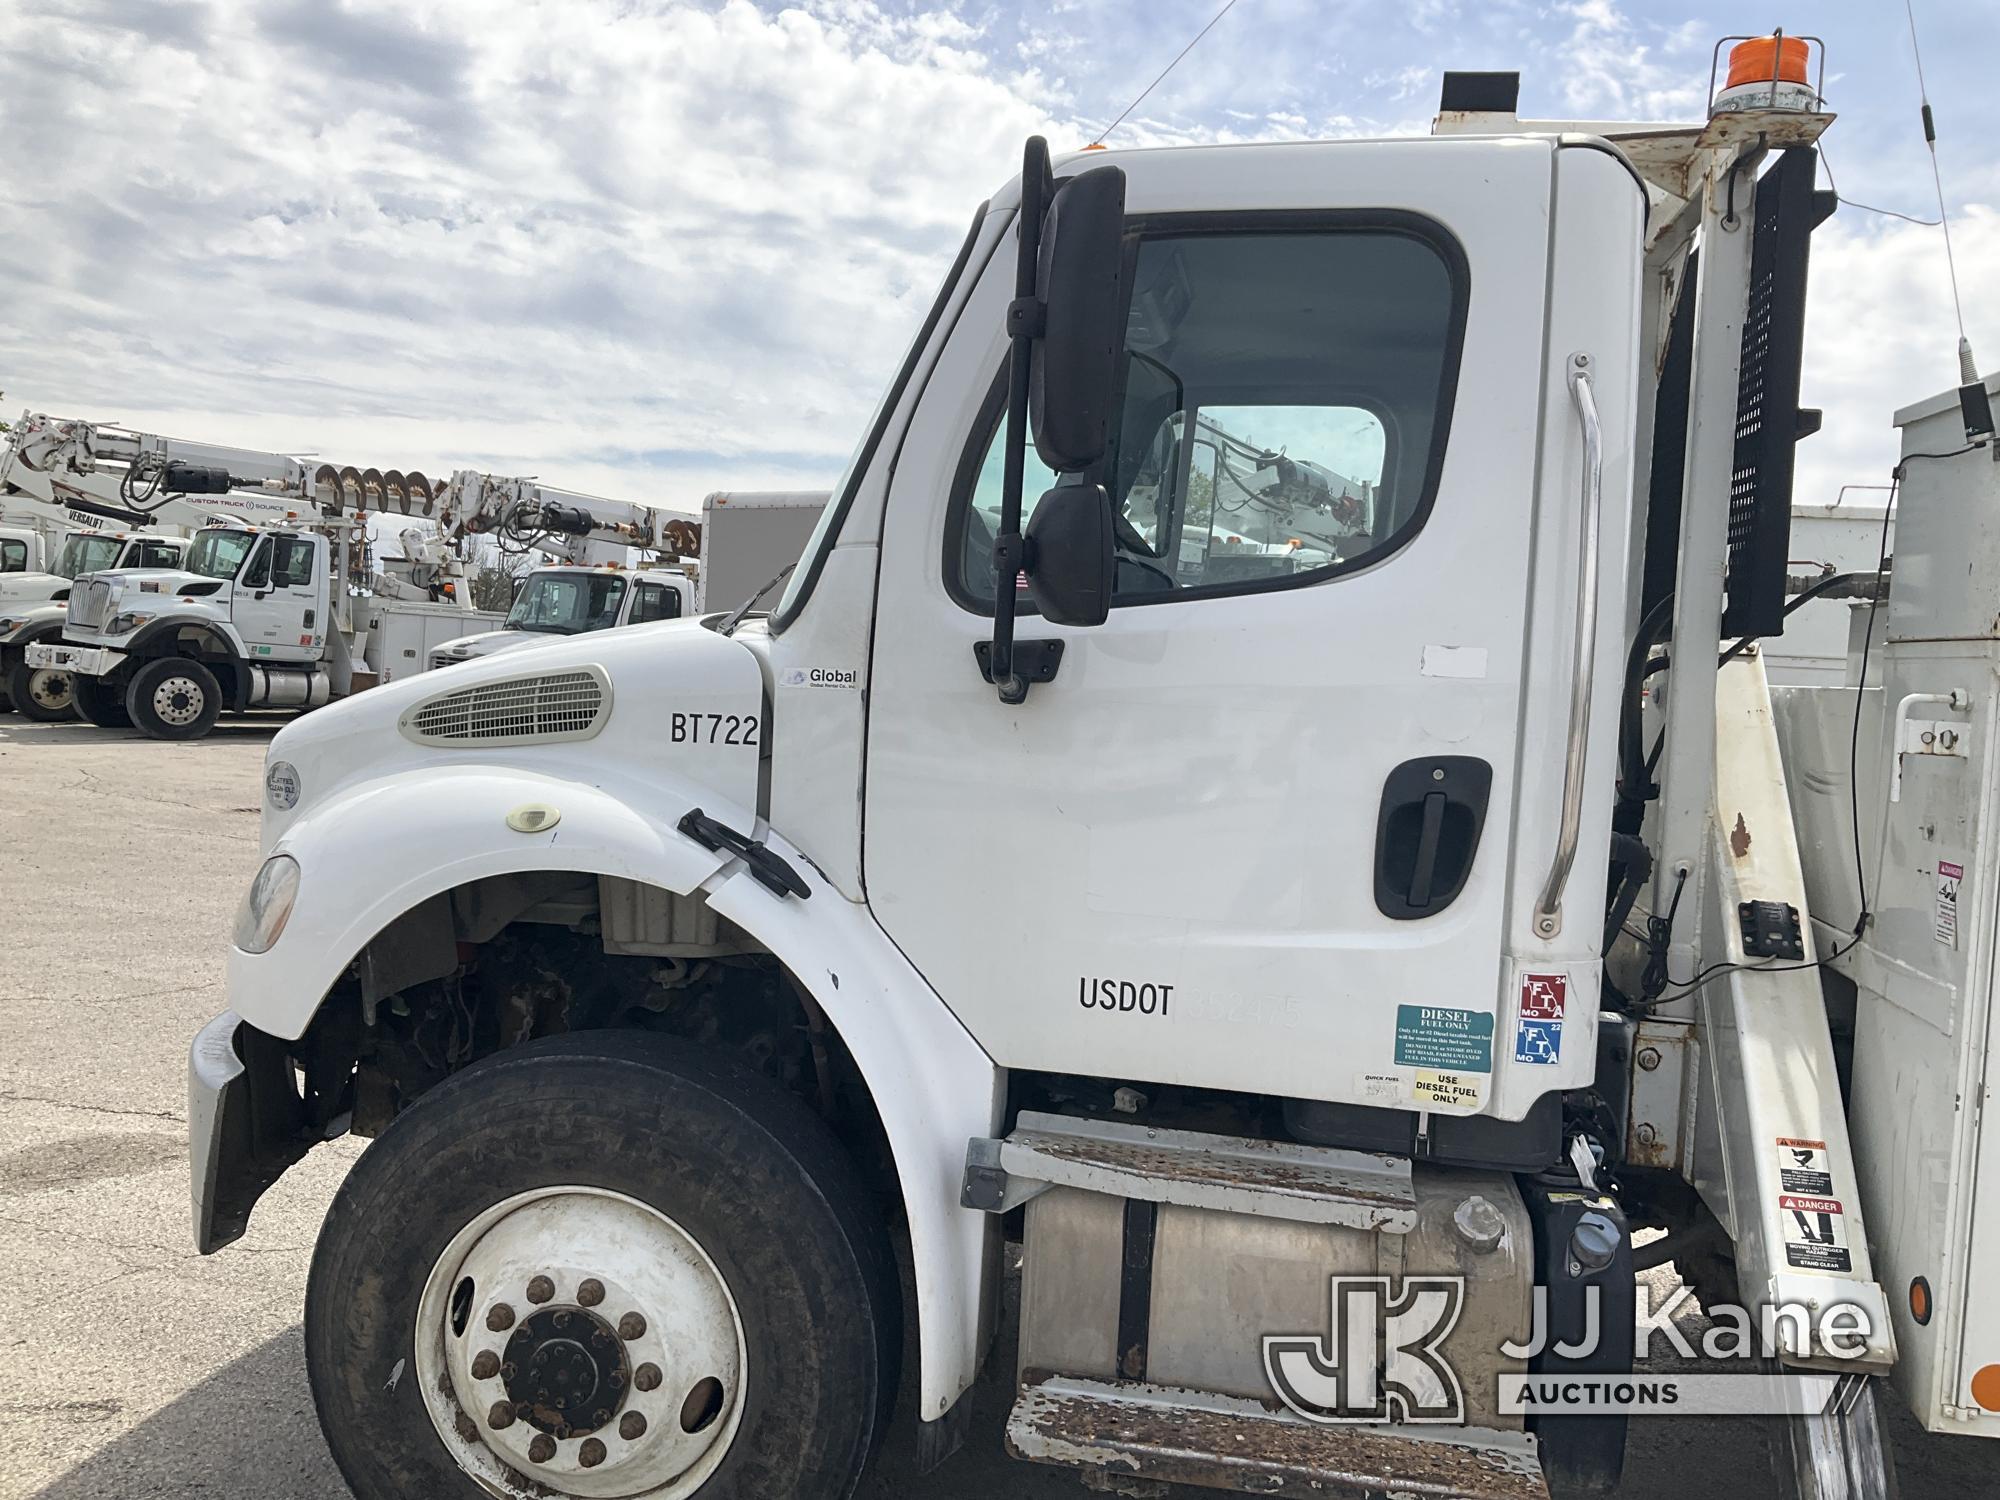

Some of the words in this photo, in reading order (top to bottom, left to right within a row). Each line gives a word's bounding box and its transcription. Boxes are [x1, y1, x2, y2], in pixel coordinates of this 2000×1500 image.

[69, 510, 104, 529] VERSALIFT
[810, 668, 856, 682] Global
[672, 713, 758, 745] BT722
[1080, 977, 1174, 1015] USDOT
[1421, 1008, 1471, 1022] DIESEL
[1421, 1020, 1444, 1028] FUEL
[1446, 1021, 1470, 1030] ONLY
[1438, 1075, 1458, 1084] USE
[1416, 1082, 1450, 1093] DIESEL
[1453, 1087, 1477, 1097] FUEL
[1433, 1094, 1458, 1104] ONLY
[1790, 1140, 1823, 1148] WARNING
[1798, 1200, 1836, 1211] DANGER
